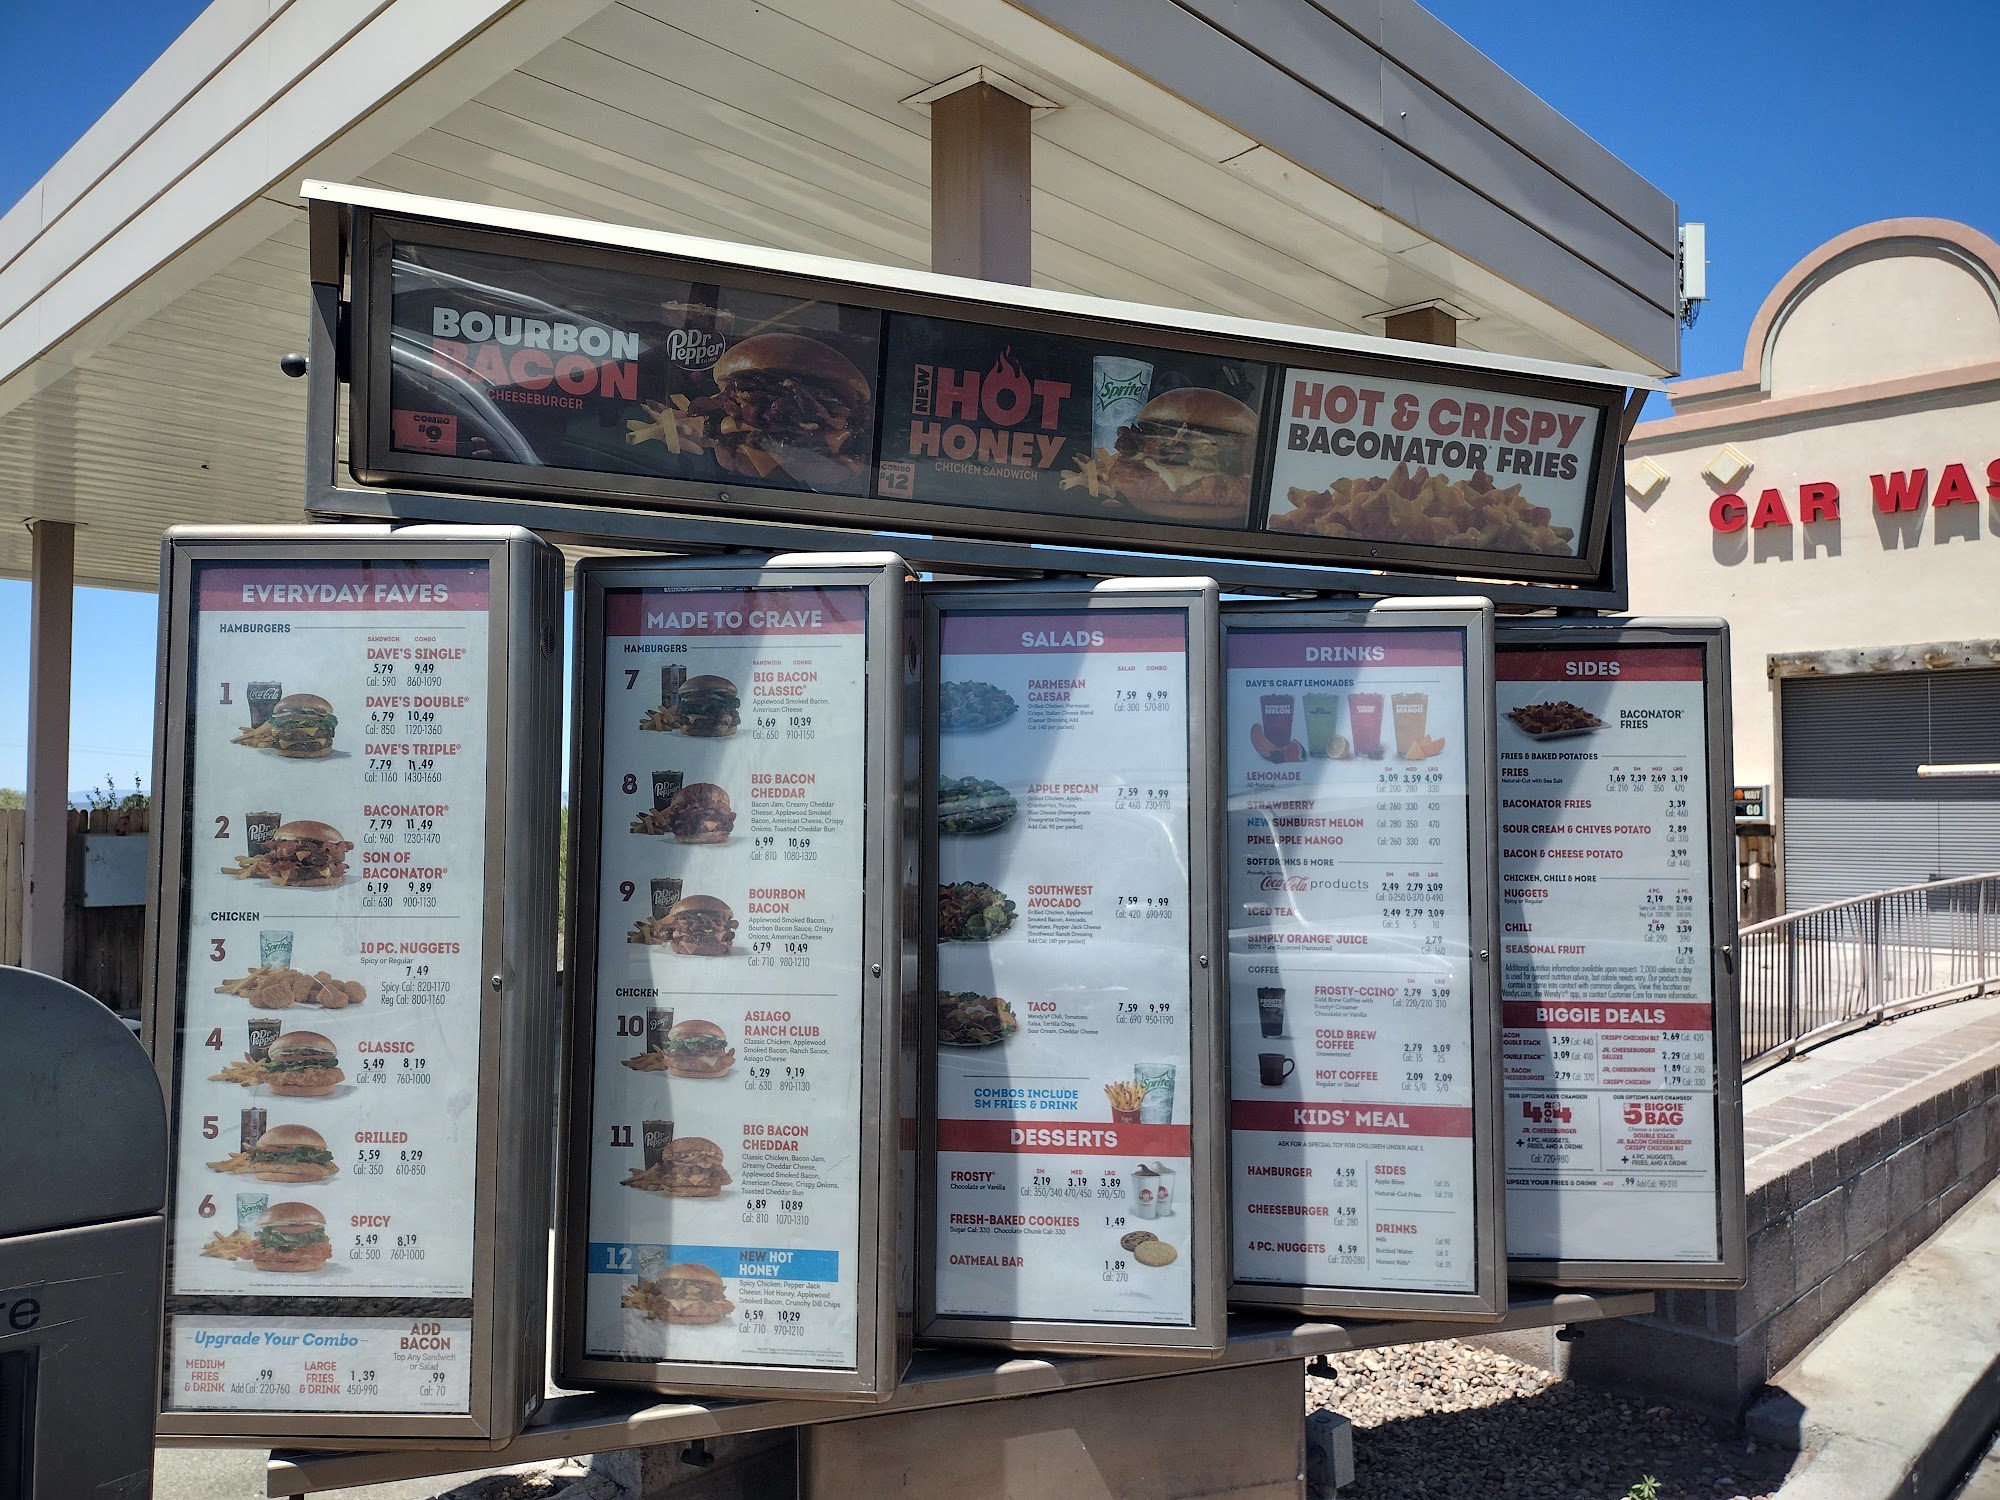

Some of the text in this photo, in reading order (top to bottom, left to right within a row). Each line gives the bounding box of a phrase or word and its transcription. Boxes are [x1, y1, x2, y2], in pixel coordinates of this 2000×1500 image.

[433, 307, 639, 360] BOURBON
[433, 338, 638, 400] BACON
[920, 368, 930, 412] NEW
[935, 358, 1071, 430] HOT
[1100, 380, 1144, 399] Sprite
[486, 388, 583, 409] CHEESEBURGER
[413, 414, 450, 425] COMBO
[1291, 381, 1586, 449] HOT & CRISPY
[909, 421, 1067, 469] HONEY
[881, 464, 911, 472] COMBO
[1496, 447, 1579, 480] FRIES
[935, 461, 1038, 481] CHICKEN SANDWICH
[1709, 482, 1841, 533] CAR
[242, 583, 448, 603] EVERYDAY FAVES
[648, 610, 822, 628] MADE TO CRAVE
[219, 622, 291, 633] HAMBURGERS
[1021, 630, 1104, 648] SALADS
[367, 647, 411, 660] DAVE'S
[1305, 645, 1385, 661] DRINKS
[373, 662, 434, 674] 5.79 9.49
[1565, 660, 1621, 675] SIDES
[366, 675, 442, 687] Cal: 590 860-1090
[624, 669, 640, 690] 7
[753, 671, 817, 682] BIG BACON
[1246, 678, 1354, 687] DAVE'S CRAFT LEMONADES
[1028, 679, 1086, 689] PARMESAN
[219, 682, 232, 705] 1
[1028, 691, 1070, 701] CAESAR
[365, 695, 410, 708] DAVE'S
[1620, 719, 1648, 728] FRIES
[751, 773, 816, 784] BIG BACON
[1247, 771, 1301, 780] LEMONADE
[622, 773, 638, 794] 8
[1028, 783, 1099, 794] APPLE PECAN
[751, 787, 806, 798] CHEDDAR
[1502, 799, 1591, 808] BACONATOR FRIES
[1746, 803, 1760, 815] GO
[214, 814, 229, 839] 2
[1247, 817, 1363, 827] NEW SUNBURST MELON
[1503, 824, 1651, 834] SOUR CREAM & CHIVES POTATO
[755, 836, 810, 849] 6.99 10.69
[363, 851, 410, 863] SON OF
[1028, 885, 1093, 895] SOUTHWEST
[1310, 878, 1369, 890] products
[620, 880, 635, 902] 9
[749, 888, 806, 899] BOURBON
[1504, 888, 1548, 897] NUGGETS
[748, 902, 789, 913] BACON
[1028, 897, 1081, 907] AVOCADO
[211, 911, 260, 922] CHICKEN
[1505, 923, 1532, 932] CHILI
[210, 937, 226, 962] 3
[360, 941, 460, 954] 10 PC. NUGGETS
[406, 965, 429, 978] 7.49
[616, 987, 659, 997] CHICKEN
[1028, 1001, 1056, 1011] TACO
[1118, 1002, 1169, 1013] 7.59 9.99
[744, 1010, 791, 1022] ASIAGO
[1536, 1007, 1665, 1024] BIGGIE DEALS
[616, 1014, 644, 1036] 10
[744, 1025, 820, 1036] RANCH CLUB
[205, 1027, 223, 1051] 4
[1316, 1029, 1376, 1039] COLD BREW
[358, 1041, 415, 1053] CLASSIC
[1316, 1039, 1354, 1049] COFFEE
[363, 1057, 426, 1070] 5.49 8.19
[1316, 1069, 1378, 1080] HOT COFFEE
[974, 1088, 1078, 1099] COMBOS INCLUDE
[974, 1099, 1077, 1110] SM FRIES & DRINK
[1644, 1102, 1684, 1111] BIGGIE
[1355, 1110, 1409, 1128] MEAL
[1645, 1112, 1684, 1125] BAG
[202, 1115, 219, 1140] 5
[743, 1124, 808, 1136] BIG BACON
[354, 1131, 408, 1144] GRILLED
[610, 1125, 634, 1147] 11
[1010, 1128, 1118, 1147] DESSERTS
[742, 1139, 799, 1150] CHEDDAR
[358, 1149, 422, 1162] 5.59 8.29
[1248, 1165, 1312, 1177] HAMBURGER
[1336, 1167, 1355, 1177] 4.59
[1375, 1164, 1406, 1175] SIDES
[198, 1193, 216, 1218] 6
[1248, 1203, 1329, 1216] CHEESEBURGER
[350, 1215, 391, 1228] SPICY
[950, 1213, 1079, 1226] FRESH-BAKED COOKIES
[1105, 1216, 1125, 1227] 1.49
[1376, 1223, 1417, 1234] DRINKS
[606, 1246, 632, 1269] 12
[739, 1250, 793, 1263] NEW HOT
[950, 1254, 1024, 1267] OATMEAL BAR
[739, 1263, 780, 1276] HONEY
[1105, 1260, 1125, 1270] 1.89
[411, 1322, 441, 1336] ADD
[195, 1330, 358, 1348] Upgrade Your Combo
[400, 1336, 450, 1350] BACON
